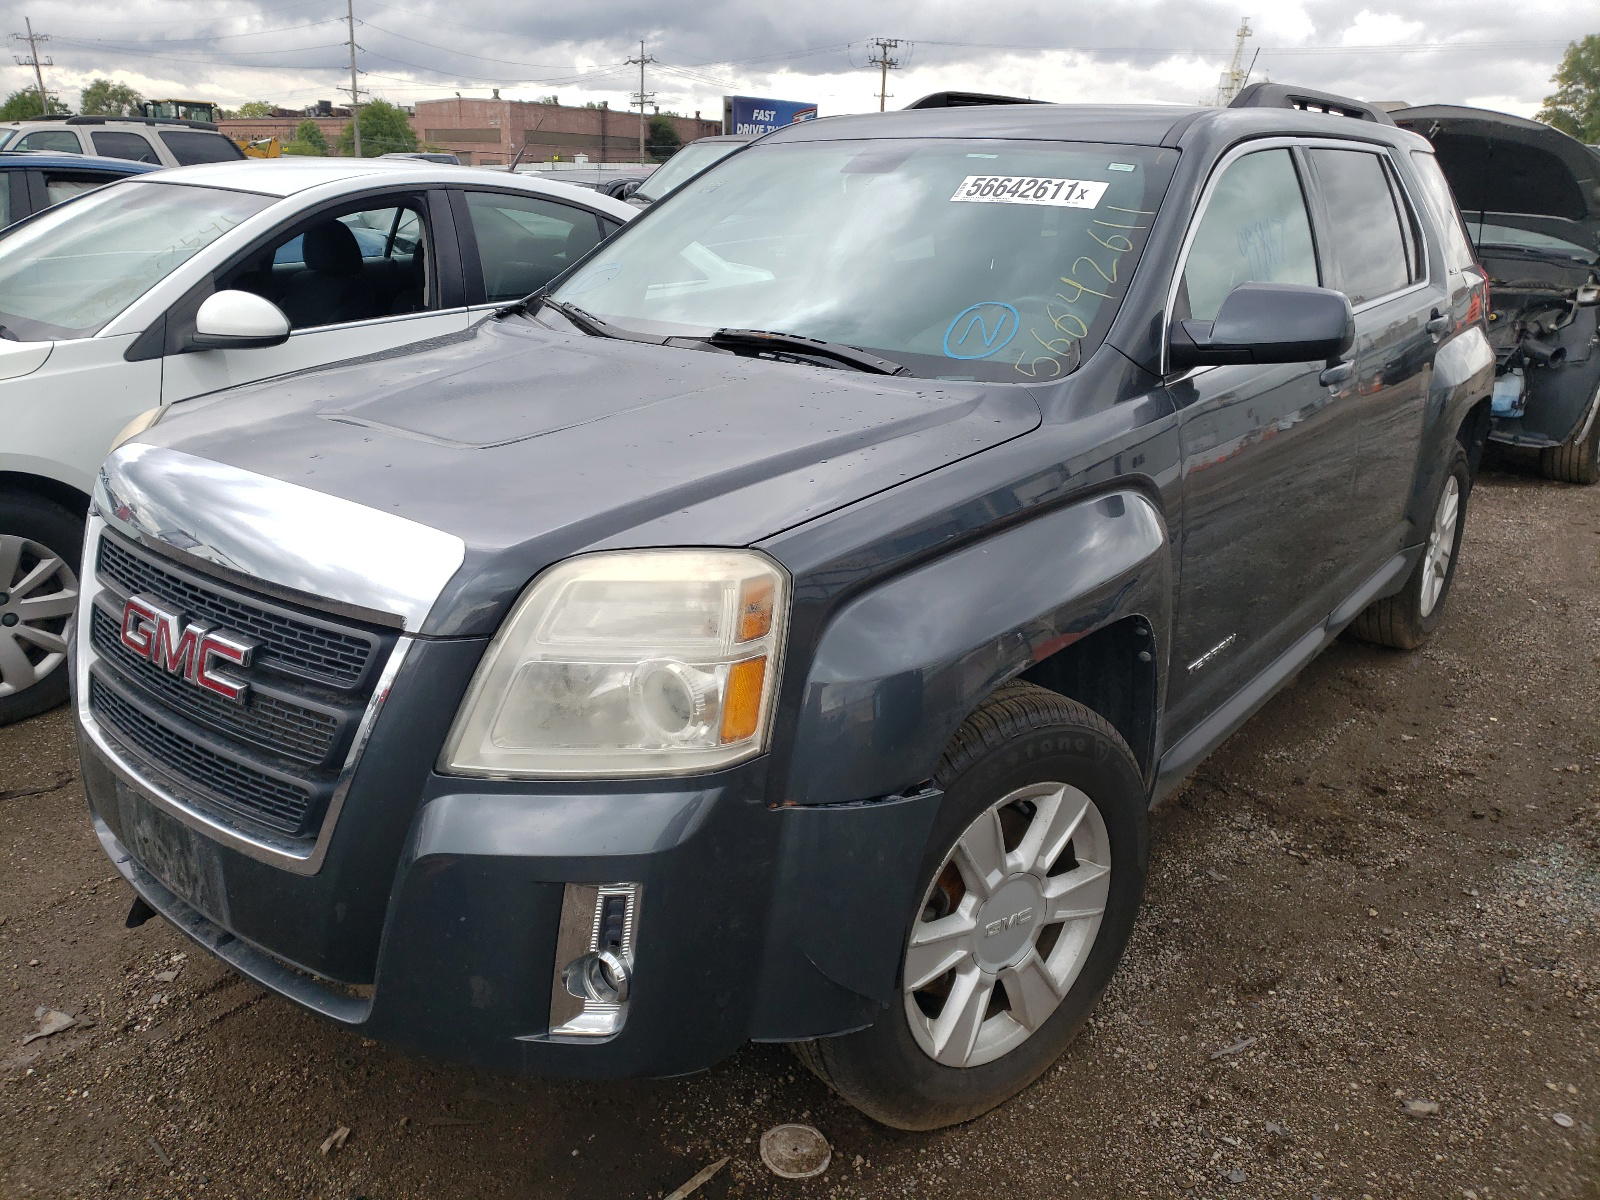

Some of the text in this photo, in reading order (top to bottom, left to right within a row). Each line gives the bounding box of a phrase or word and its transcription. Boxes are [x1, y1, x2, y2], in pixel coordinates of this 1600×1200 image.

[736, 123, 764, 135] DRIVE
[752, 109, 776, 121] FAST
[1014, 205, 1155, 377] 56642611
[120, 596, 252, 705] GMC
[985, 907, 1033, 937] GMC
